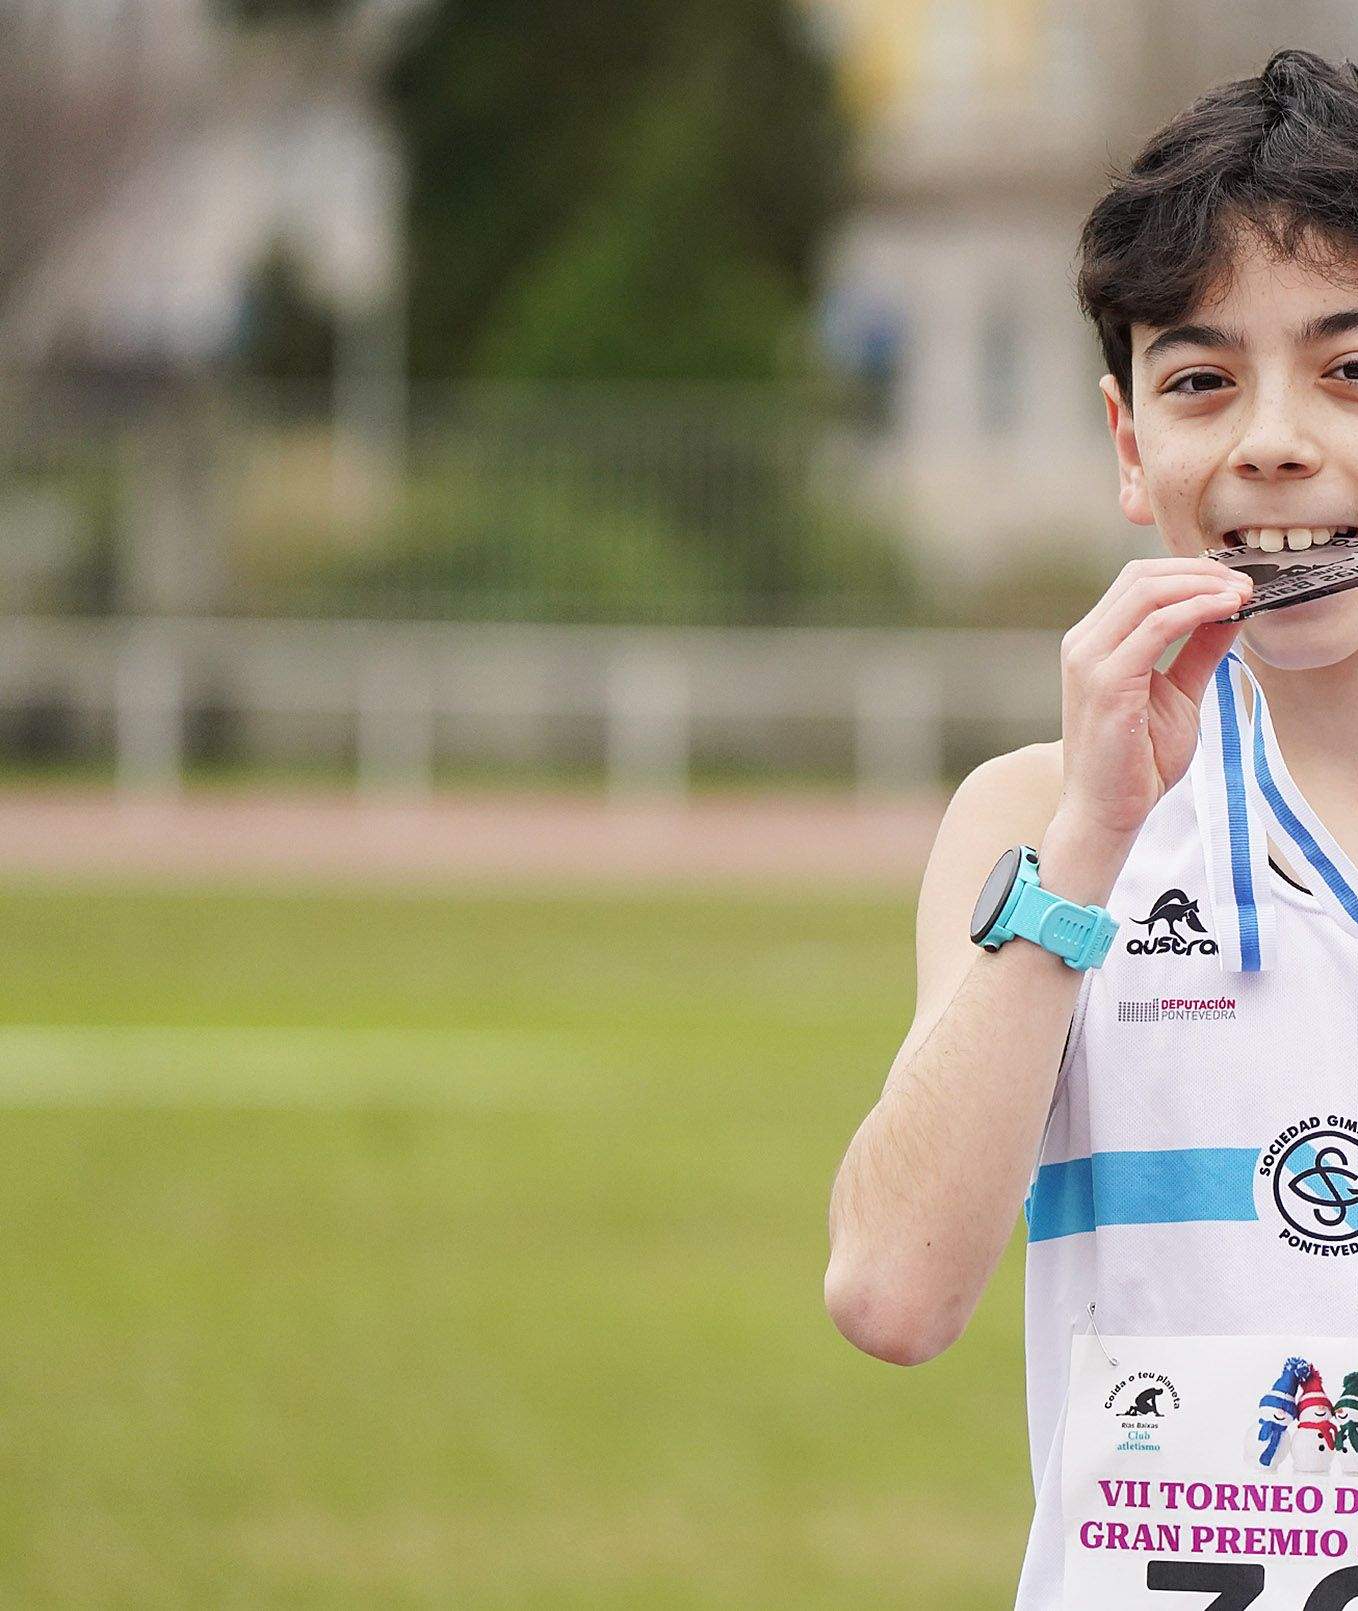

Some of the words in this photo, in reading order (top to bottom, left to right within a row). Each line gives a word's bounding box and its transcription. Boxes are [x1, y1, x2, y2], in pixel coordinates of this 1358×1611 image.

[1126, 936, 1219, 956] austra
[1161, 997, 1236, 1010] DEPUTACIÓN
[1161, 1010, 1236, 1021] PONTEVEDRA
[1259, 1116, 1321, 1177] SOCIEDAD
[1104, 1381, 1127, 1409] Coida
[1138, 1371, 1155, 1379] teu
[1156, 1375, 1181, 1409] planeta
[1128, 1431, 1151, 1440] Club
[1117, 1442, 1160, 1452] atletismo
[1098, 1480, 1151, 1507] VII
[1160, 1482, 1324, 1514] TORNEO
[1080, 1521, 1181, 1552] GRAN
[1191, 1525, 1348, 1557] PREMIO
